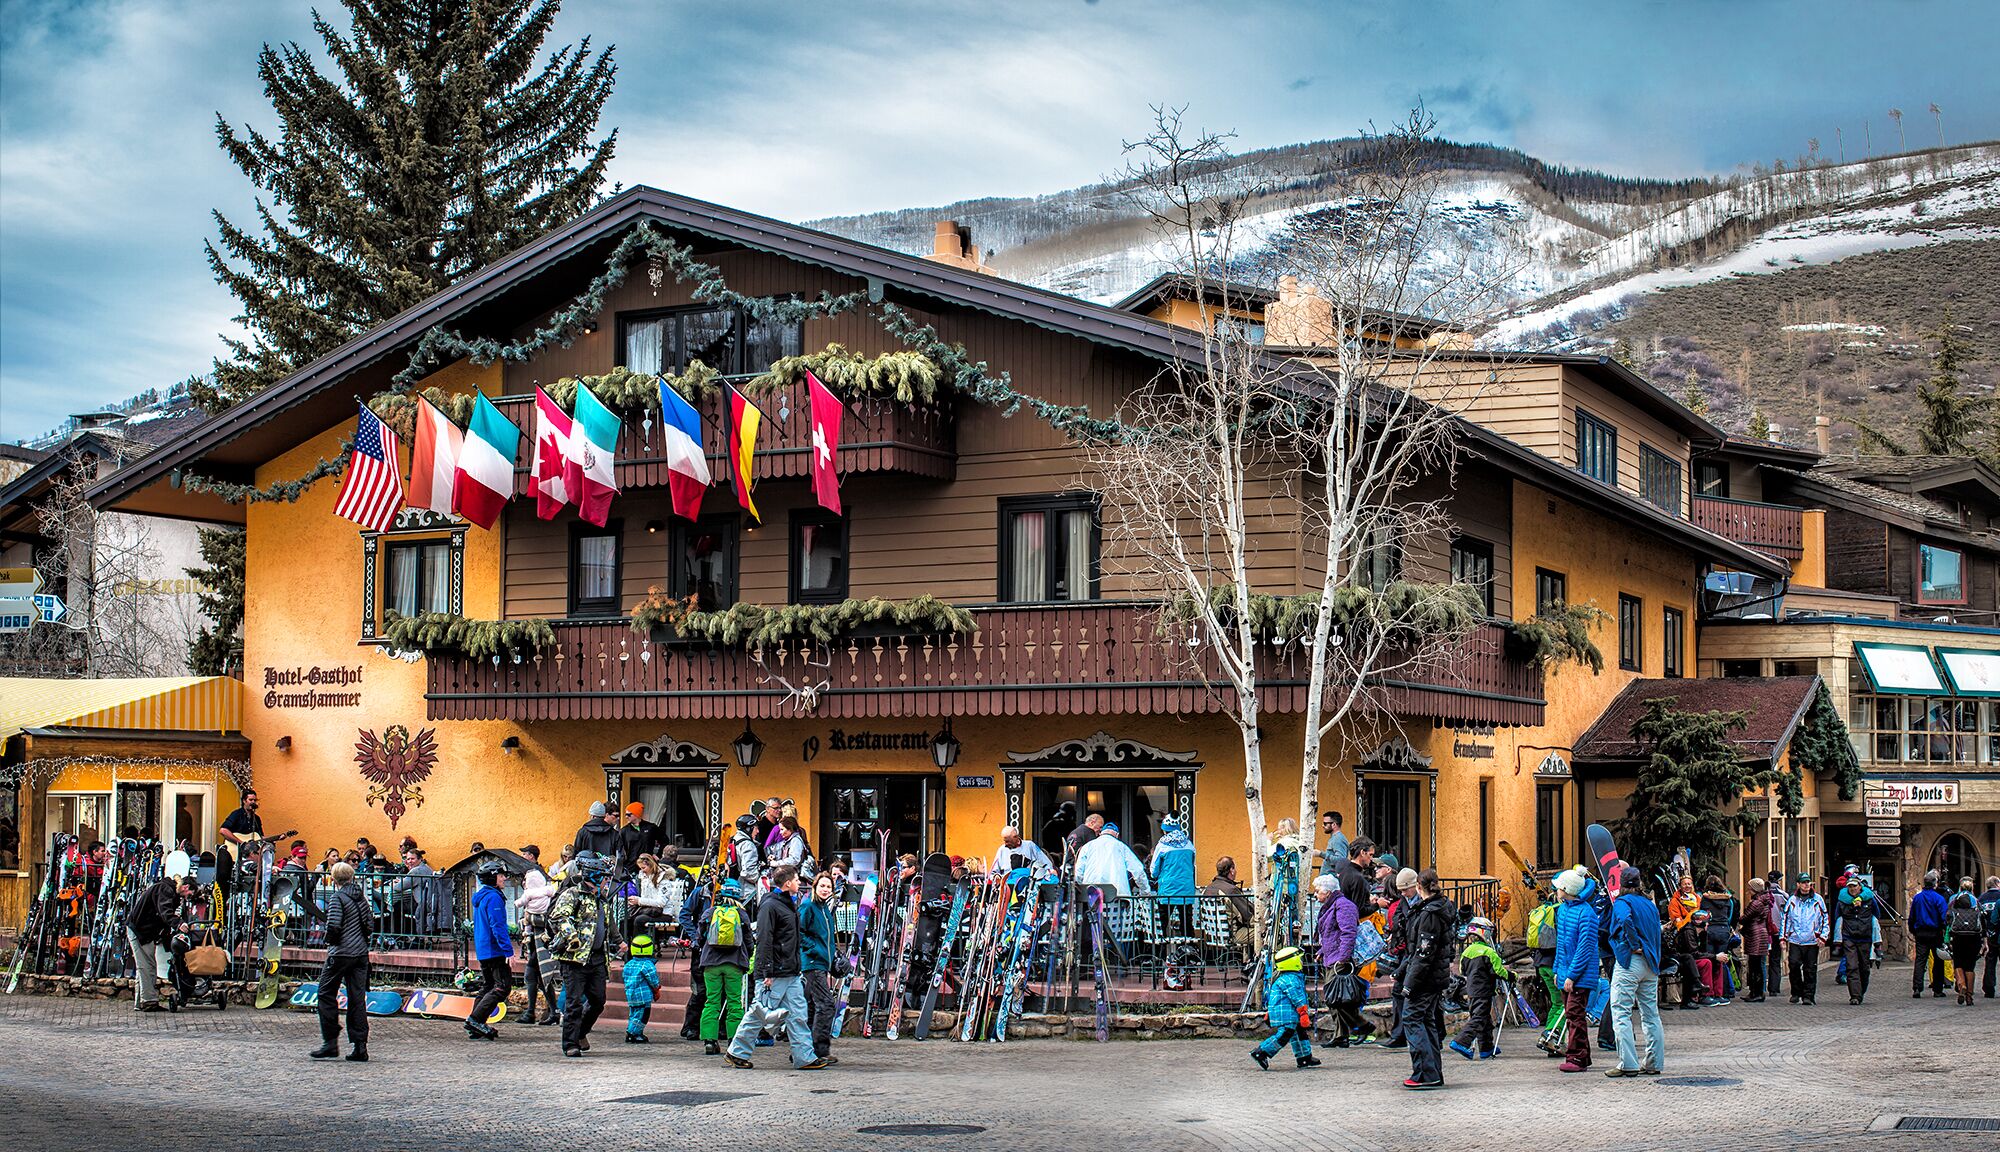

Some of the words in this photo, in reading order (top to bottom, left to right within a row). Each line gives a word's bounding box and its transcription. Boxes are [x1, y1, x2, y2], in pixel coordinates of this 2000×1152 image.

[264, 665, 363, 689] Hotel-Gasthof
[264, 689, 361, 710] Gramshammer
[802, 735, 820, 762] 19
[828, 728, 931, 751] Restaurant
[1911, 785, 1943, 802] Sports
